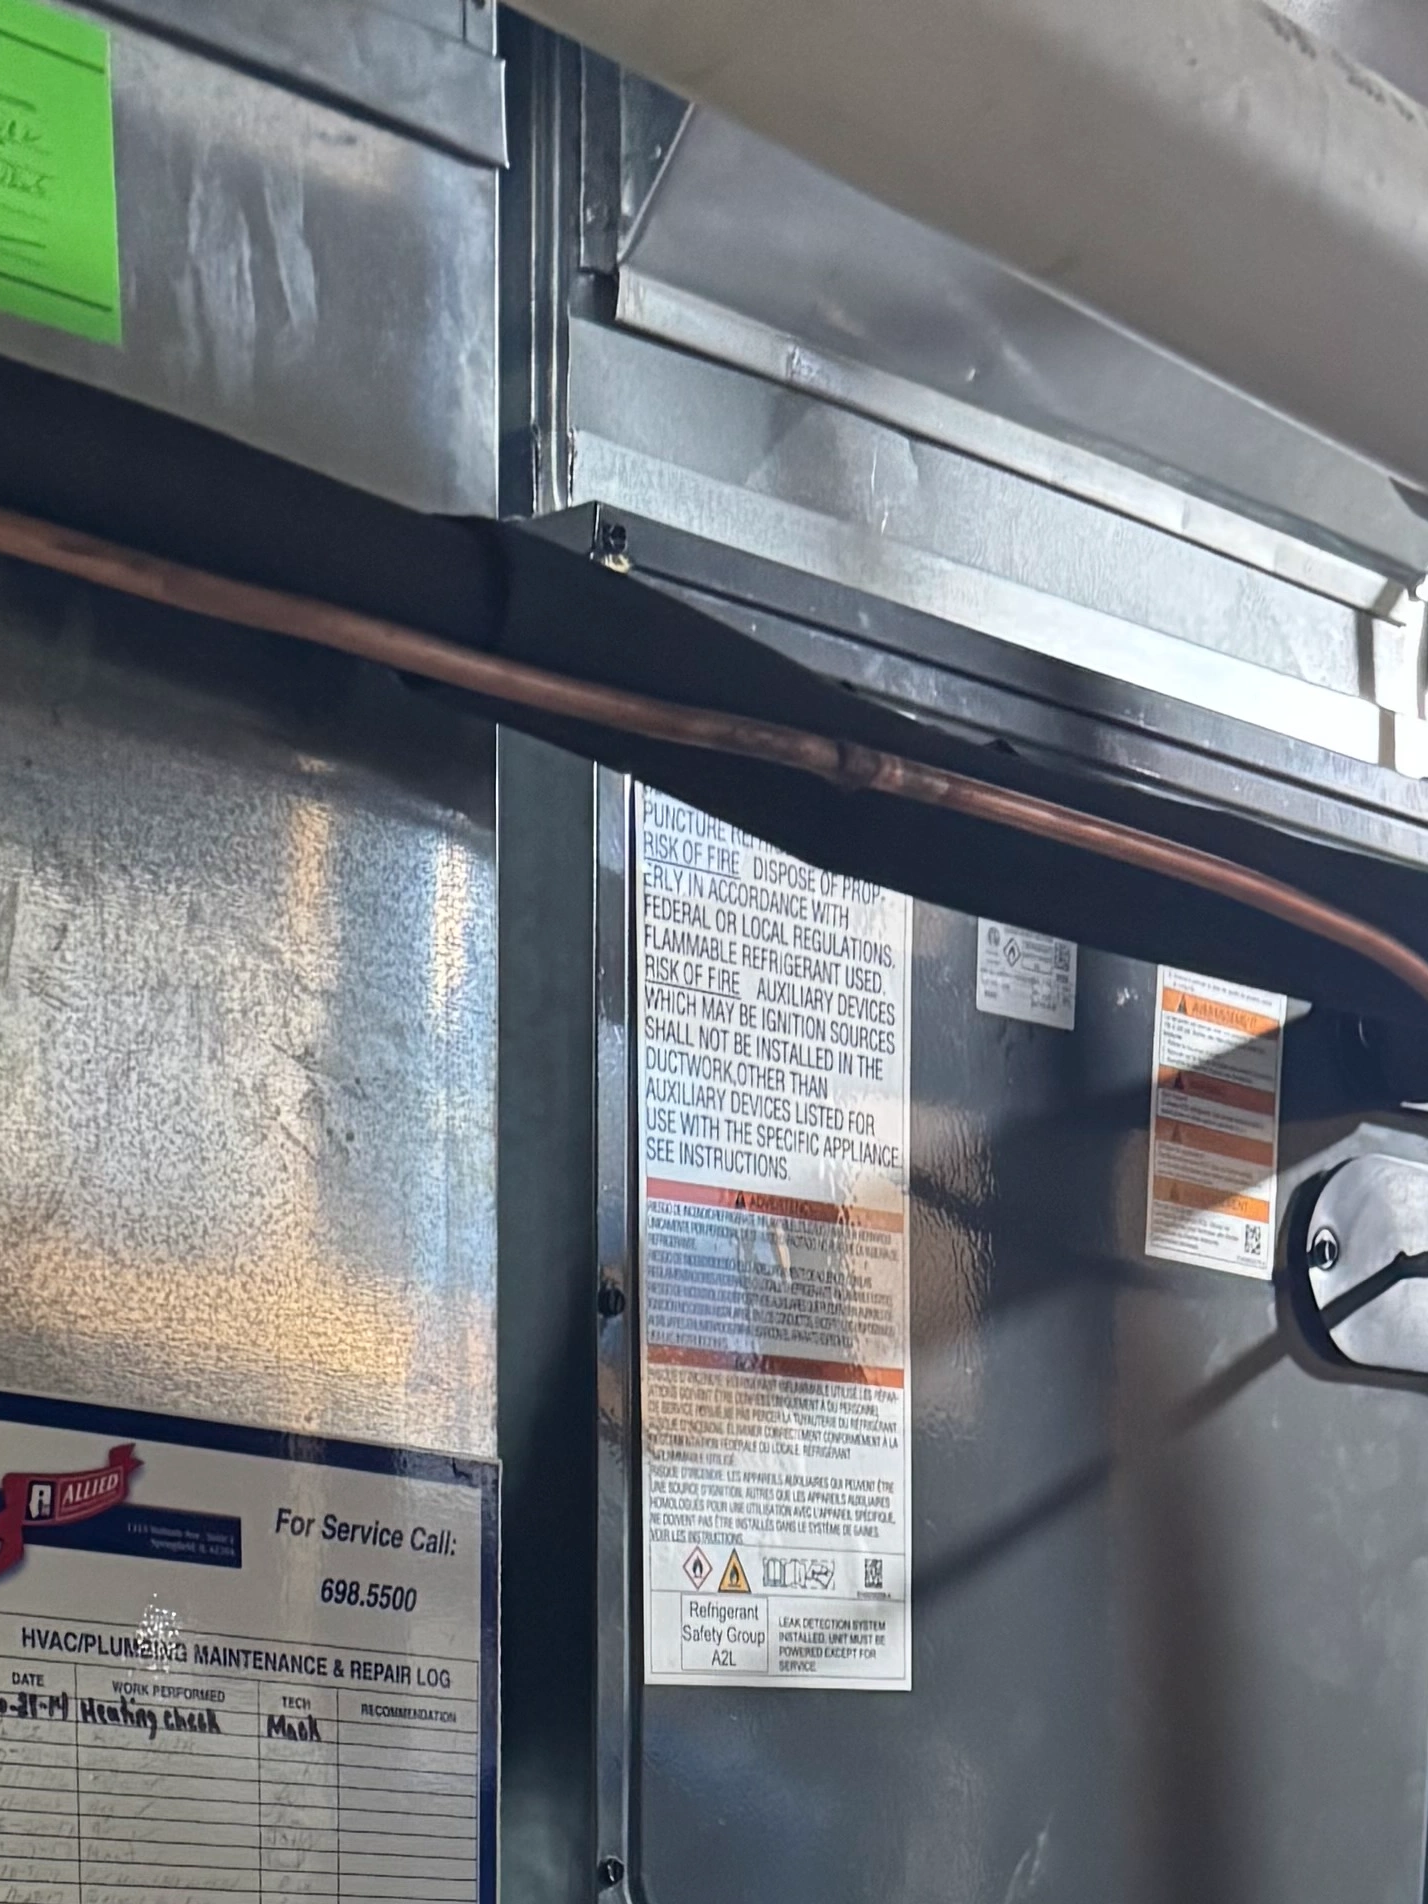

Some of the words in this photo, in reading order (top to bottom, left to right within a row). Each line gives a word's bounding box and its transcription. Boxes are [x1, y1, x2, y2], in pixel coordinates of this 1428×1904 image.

[643, 831, 679, 861] RISK
[683, 841, 701, 866] OF
[708, 845, 740, 875] FIRE
[754, 856, 815, 892] DISPOSE
[821, 869, 838, 897] OF
[688, 872, 703, 898] IN
[708, 877, 807, 920] ACCORDANCE
[812, 899, 849, 930] WITH
[644, 894, 711, 929] FEDERAL
[716, 908, 737, 934] OR
[742, 913, 788, 946] LOCAL
[793, 924, 895, 969] REGULATIONS.
[644, 924, 737, 965] FLAMMABLE
[742, 944, 840, 985] REFRIGERANT
[846, 963, 885, 996] USED.
[645, 955, 679, 984] RISK
[683, 962, 702, 987] OF
[708, 967, 740, 994] FIRE
[757, 977, 834, 1014] AUXILIARY
[838, 994, 895, 1026] DEVICES
[645, 985, 697, 1017] WHICH
[702, 997, 734, 1024] MAY
[739, 1003, 757, 1029] BE
[762, 1007, 826, 1042] IGNITION
[830, 1022, 895, 1055] SOURCES
[645, 1015, 694, 1046] SHALL
[699, 1027, 728, 1052] NOT
[734, 1031, 751, 1058] BE
[756, 1036, 834, 1072] INSTALLED
[838, 1051, 853, 1075] IN
[858, 1054, 884, 1081] THE
[646, 1077, 726, 1111] AUXILIARY
[731, 1091, 791, 1122] DEVICES
[795, 1101, 844, 1130] LISTED
[849, 1110, 875, 1137] FOR
[790, 1071, 828, 1100] THAN
[646, 1107, 676, 1133] USE
[680, 1113, 719, 1141] WITH
[725, 1119, 752, 1145] THE
[756, 1124, 820, 1156] SPECIFIC
[646, 1137, 675, 1163] SEE
[679, 1142, 791, 1181] INSTRUCTIONS.
[61, 1474, 119, 1505] ALLIED
[275, 1508, 315, 1537] For
[322, 1514, 403, 1549] Service
[410, 1526, 457, 1556] Call:
[321, 1578, 417, 1612] 698.5500
[689, 1600, 758, 1623] Refrigerant
[682, 1624, 723, 1645] Safety
[726, 1627, 765, 1647] Group
[778, 1617, 801, 1629] LEAK
[802, 1618, 851, 1631] DETECTION
[848, 1633, 873, 1646] MUST
[22, 1627, 187, 1663] HVAC/PLUMBING
[194, 1643, 327, 1677] MAINTENANCE
[333, 1659, 345, 1678] &
[350, 1660, 411, 1685] REPAIR
[417, 1667, 451, 1688] LOG
[711, 1650, 736, 1667] A2L
[779, 1646, 823, 1659] POWERED
[824, 1647, 858, 1660] EXCEPT
[859, 1648, 877, 1660] FOR
[12, 1672, 44, 1687] DATE
[112, 1680, 148, 1697] WORK
[153, 1685, 225, 1703] PERFORMED
[282, 1696, 311, 1710] TECH
